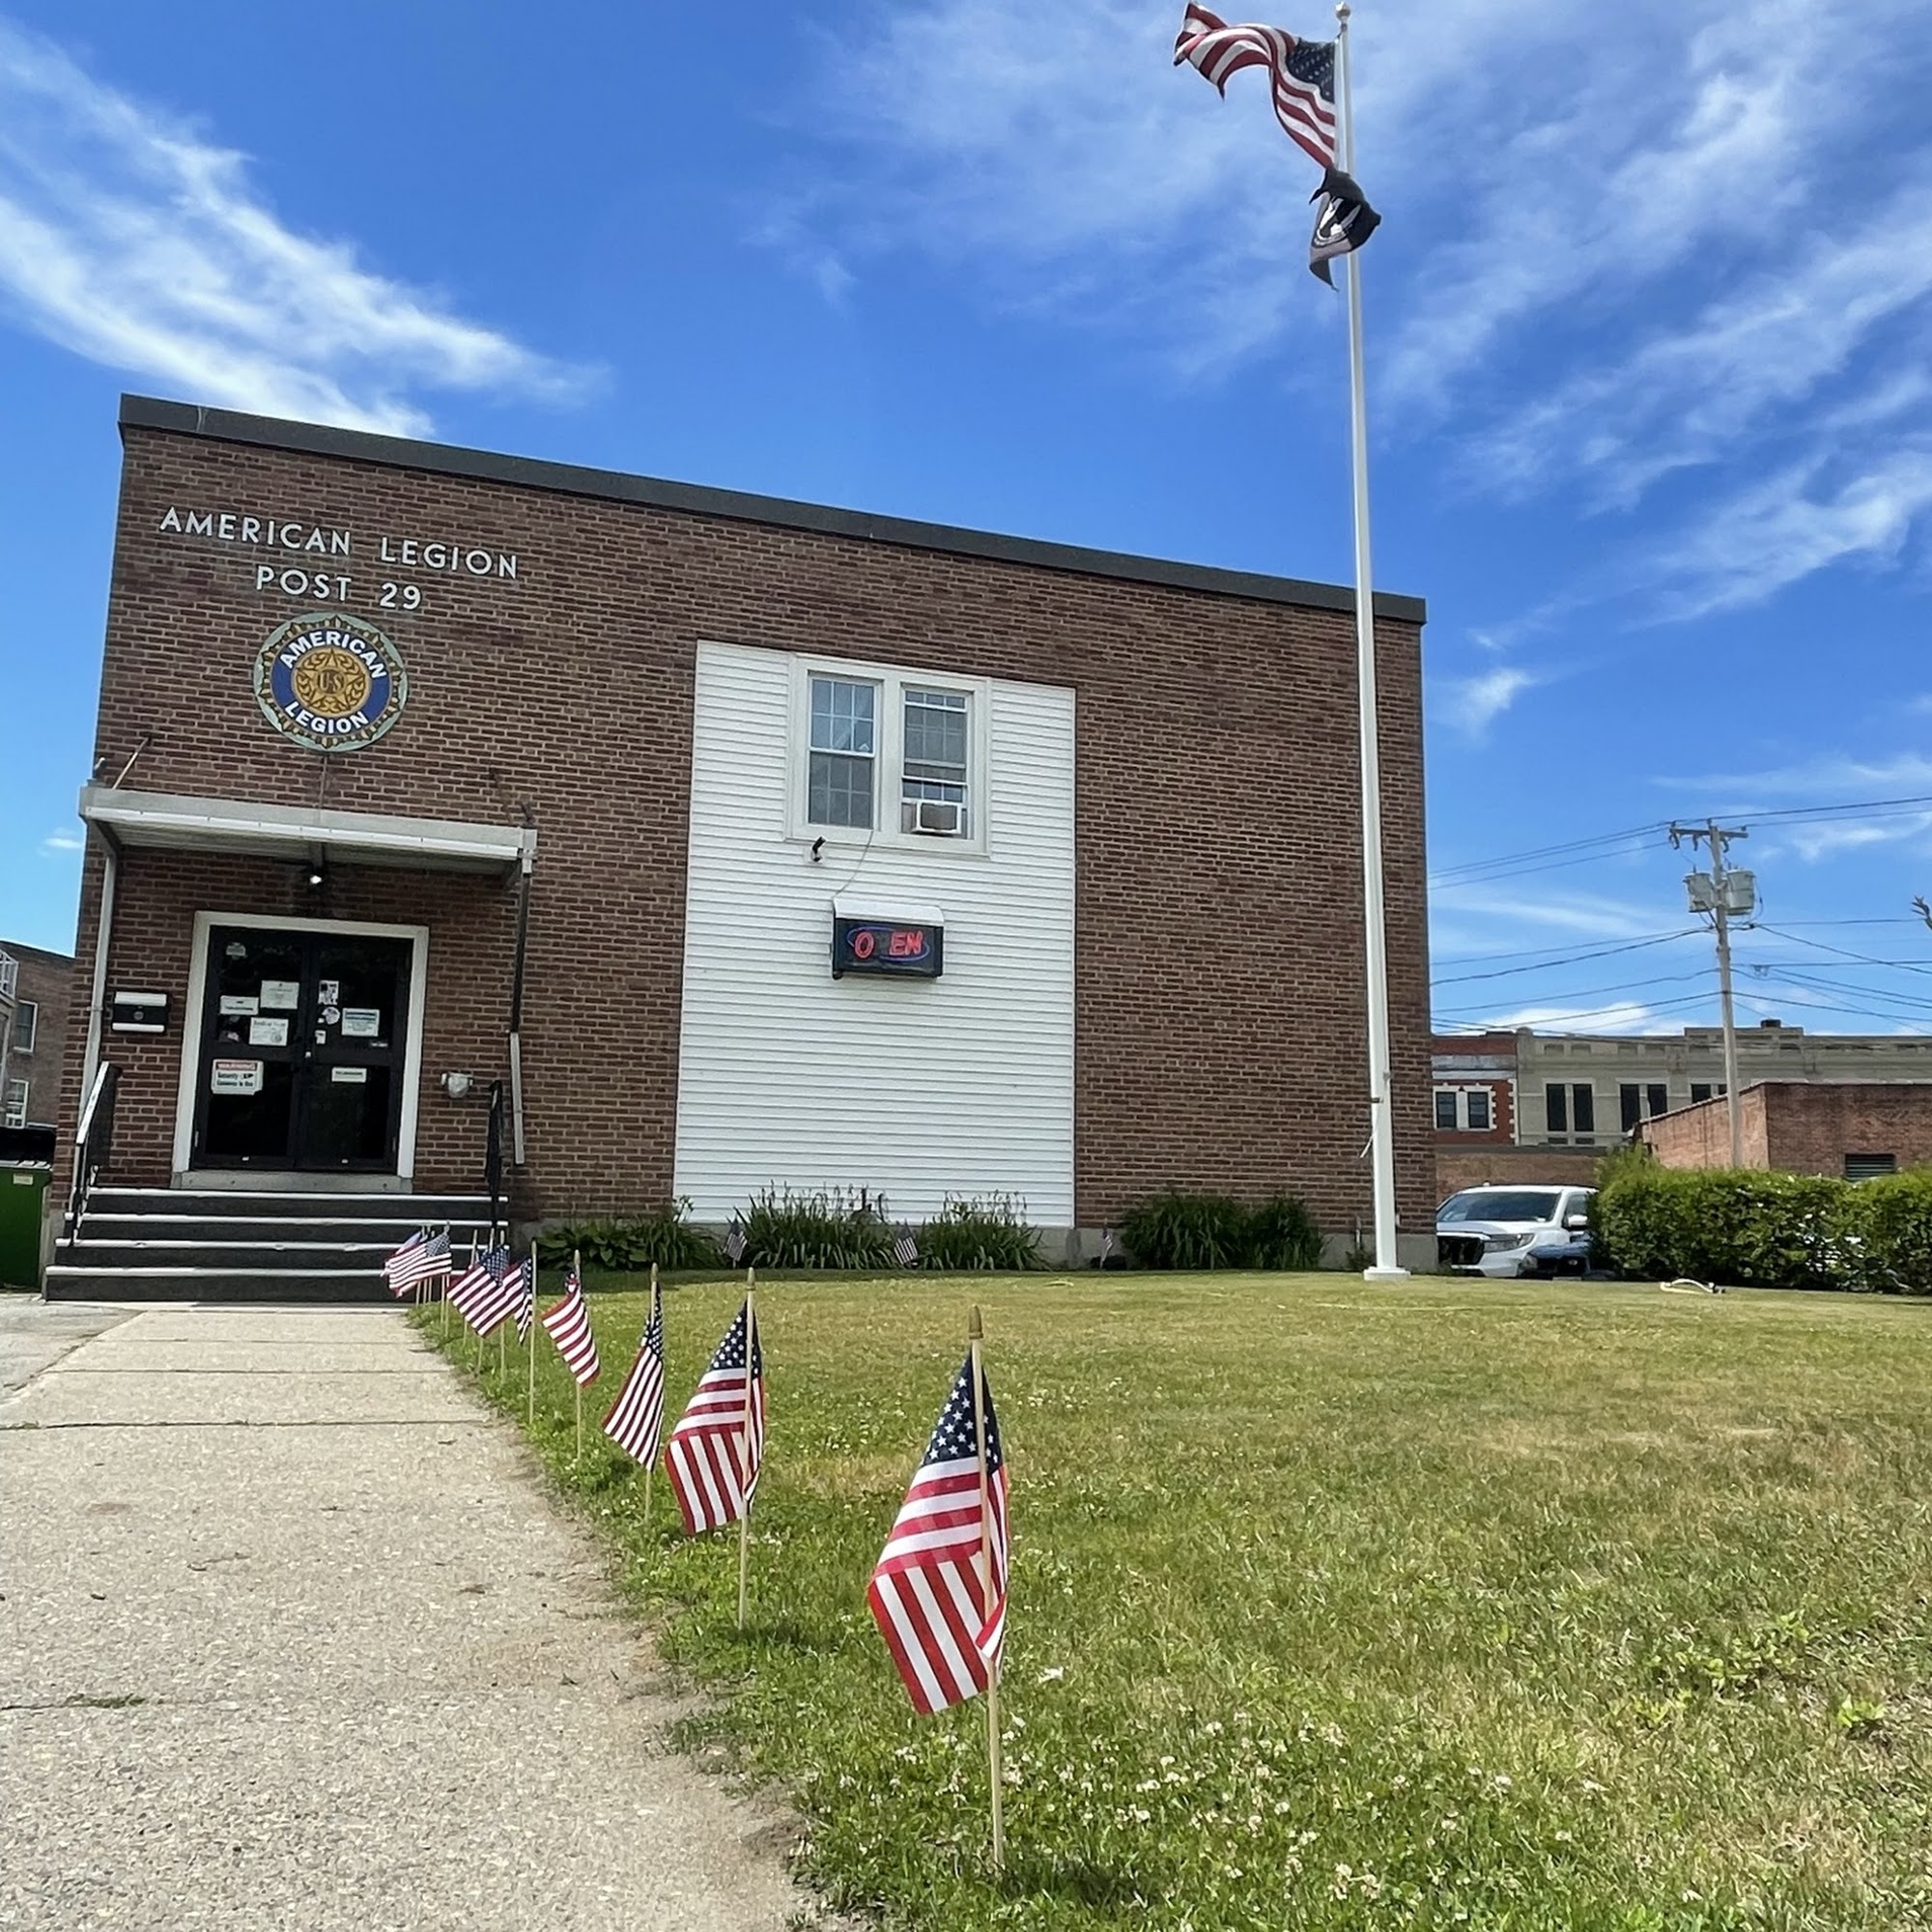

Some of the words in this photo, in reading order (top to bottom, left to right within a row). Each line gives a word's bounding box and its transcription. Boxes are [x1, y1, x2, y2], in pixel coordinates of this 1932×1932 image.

[159, 505, 351, 555] AMERICAN
[381, 537, 517, 579] LEGION
[256, 565, 352, 602] POST
[380, 582, 421, 610] 29
[280, 631, 387, 678] AMERICAN
[285, 701, 369, 734] LEGION
[854, 929, 923, 958] OEN
